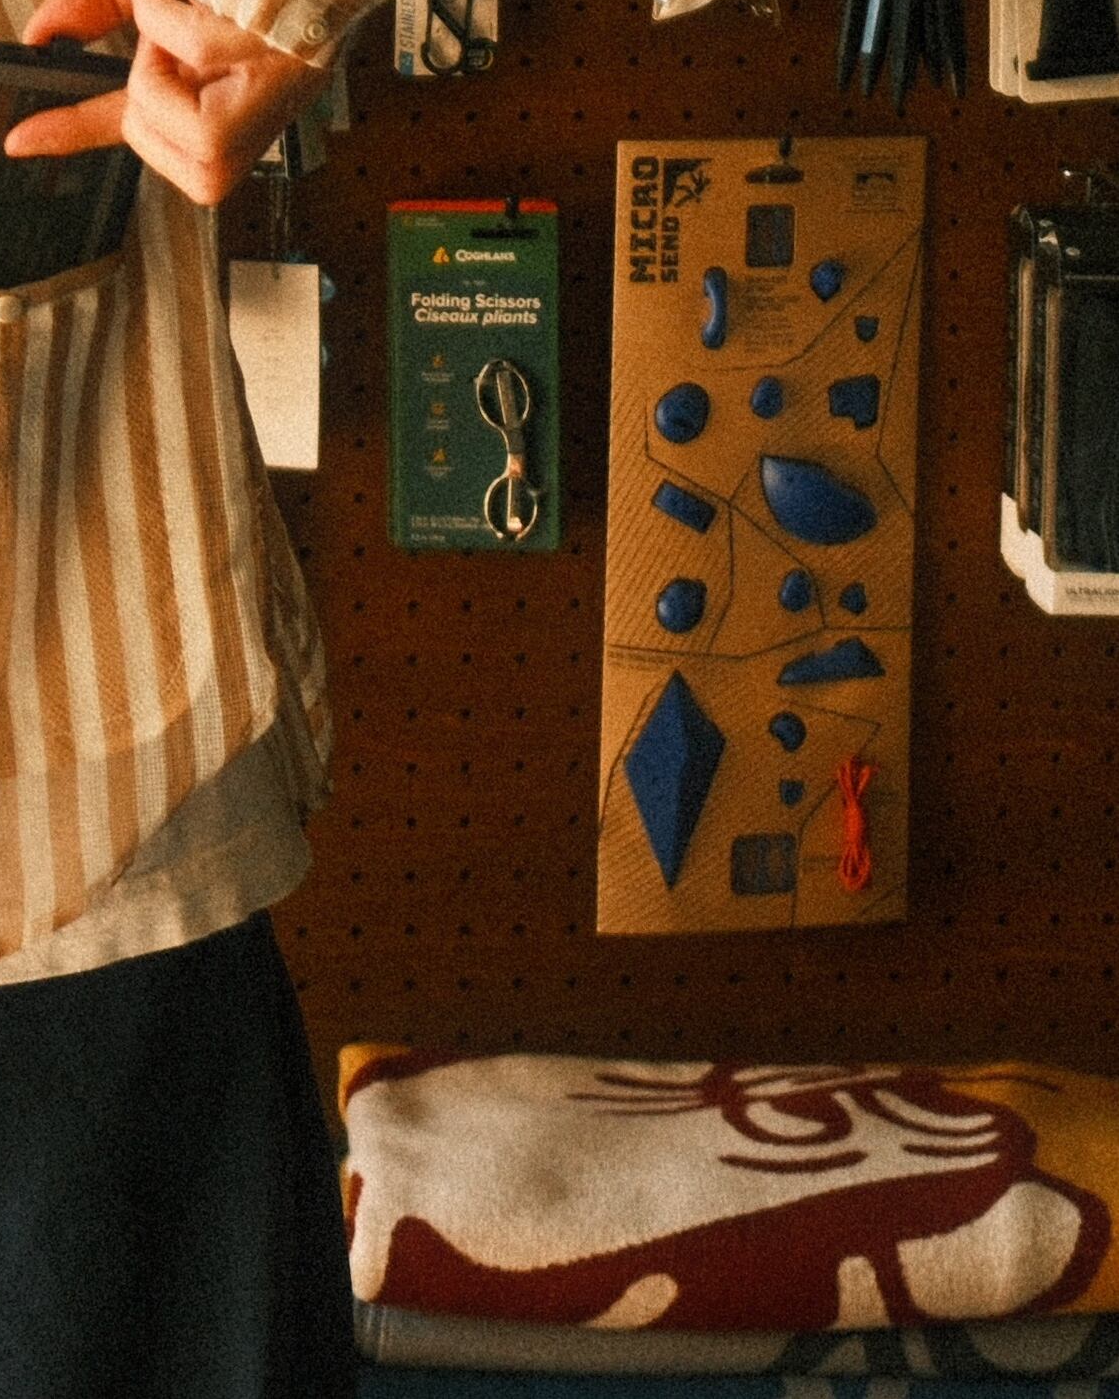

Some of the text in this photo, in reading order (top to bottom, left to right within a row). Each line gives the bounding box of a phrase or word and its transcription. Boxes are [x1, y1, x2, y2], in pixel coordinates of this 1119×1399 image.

[630, 156, 659, 283] MICRO
[661, 216, 680, 283] SEND
[411, 292, 541, 311] Folding Scissors
[414, 308, 538, 326] Ciseaux pliants
